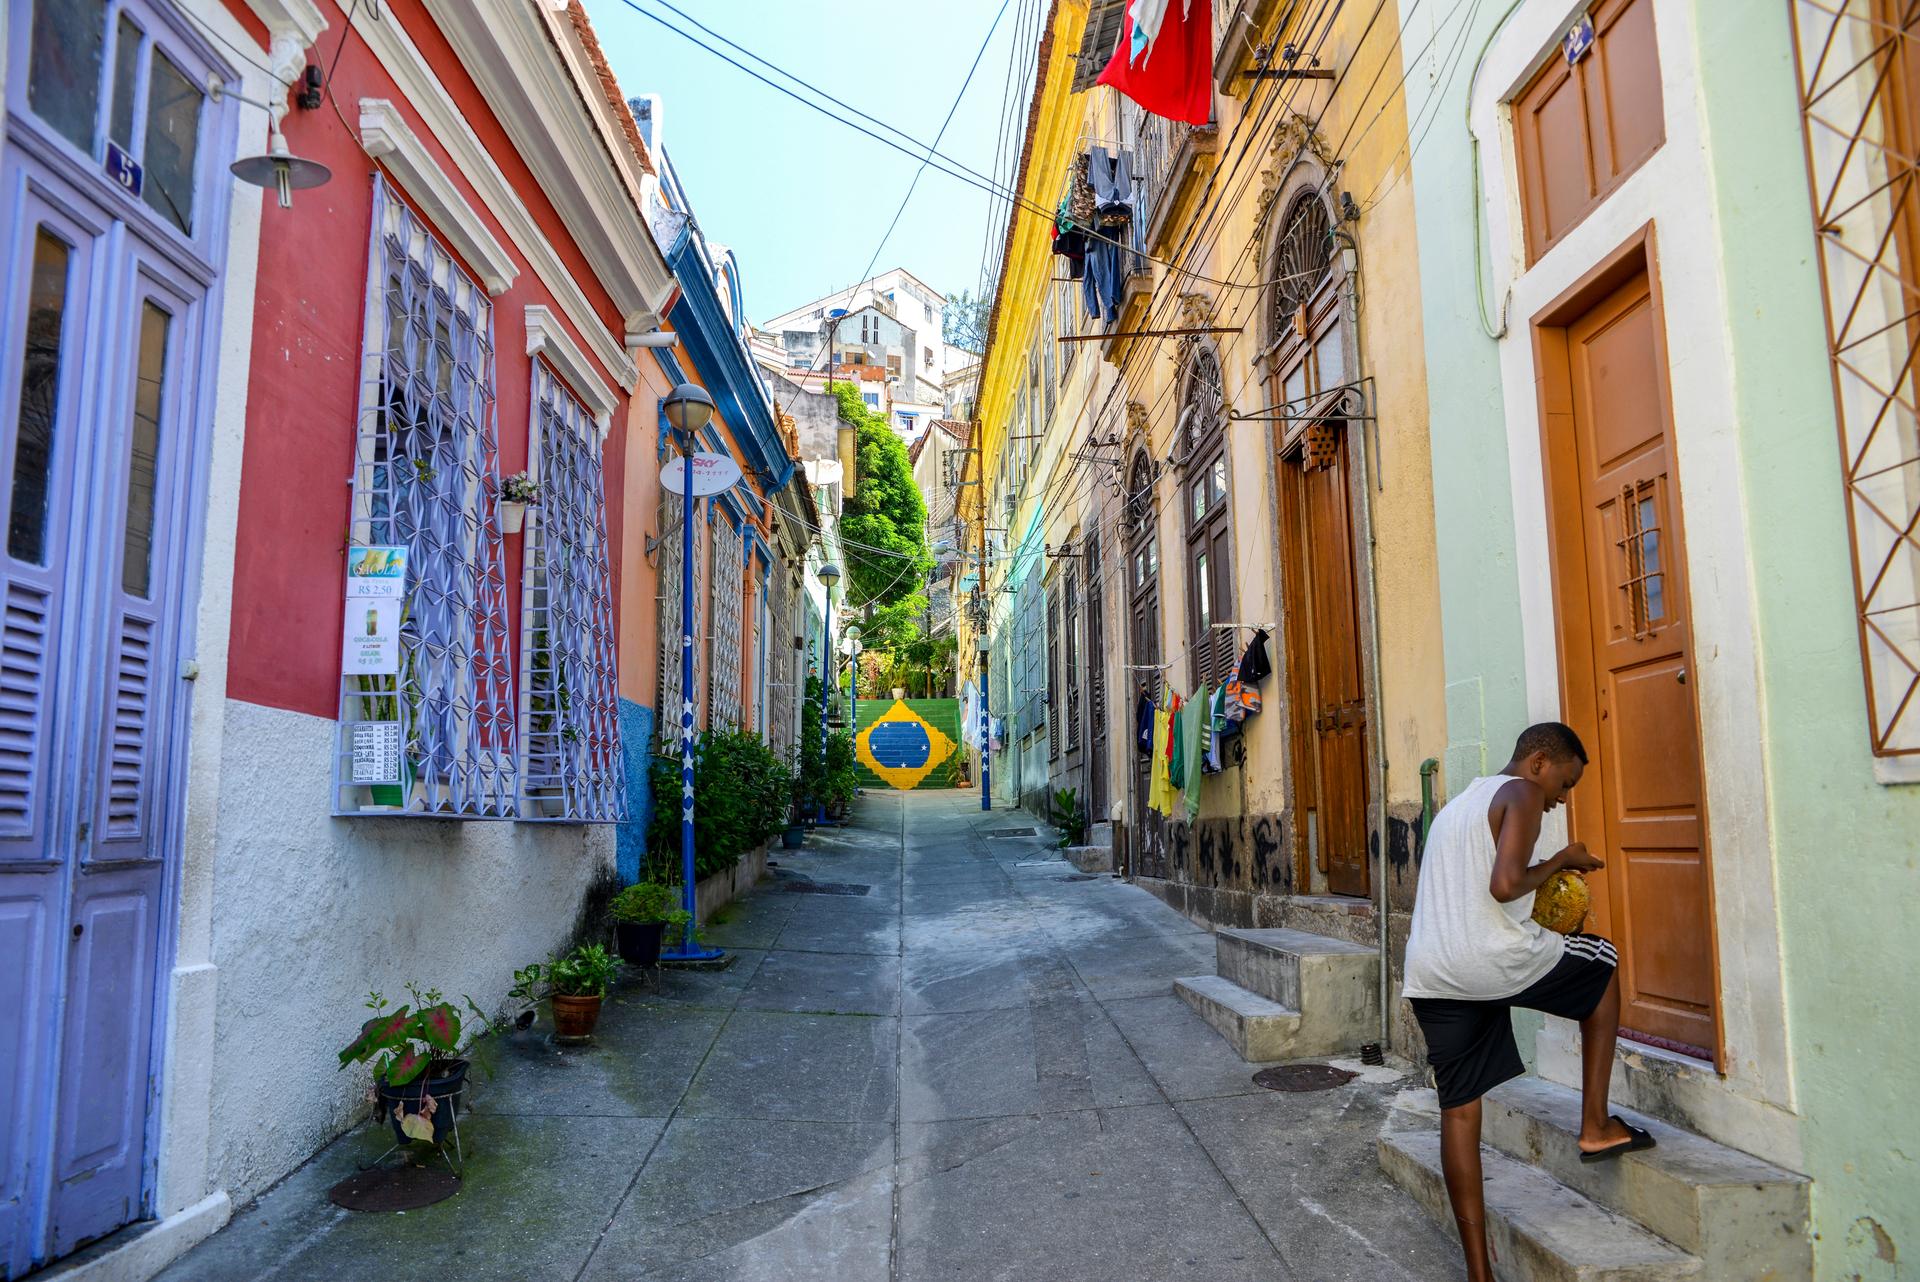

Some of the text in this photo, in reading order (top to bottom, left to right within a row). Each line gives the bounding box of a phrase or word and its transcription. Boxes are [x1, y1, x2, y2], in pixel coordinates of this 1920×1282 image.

[120, 154, 133, 187] 5
[692, 457, 719, 468] SKY
[359, 585, 392, 595] R$ 2,50
